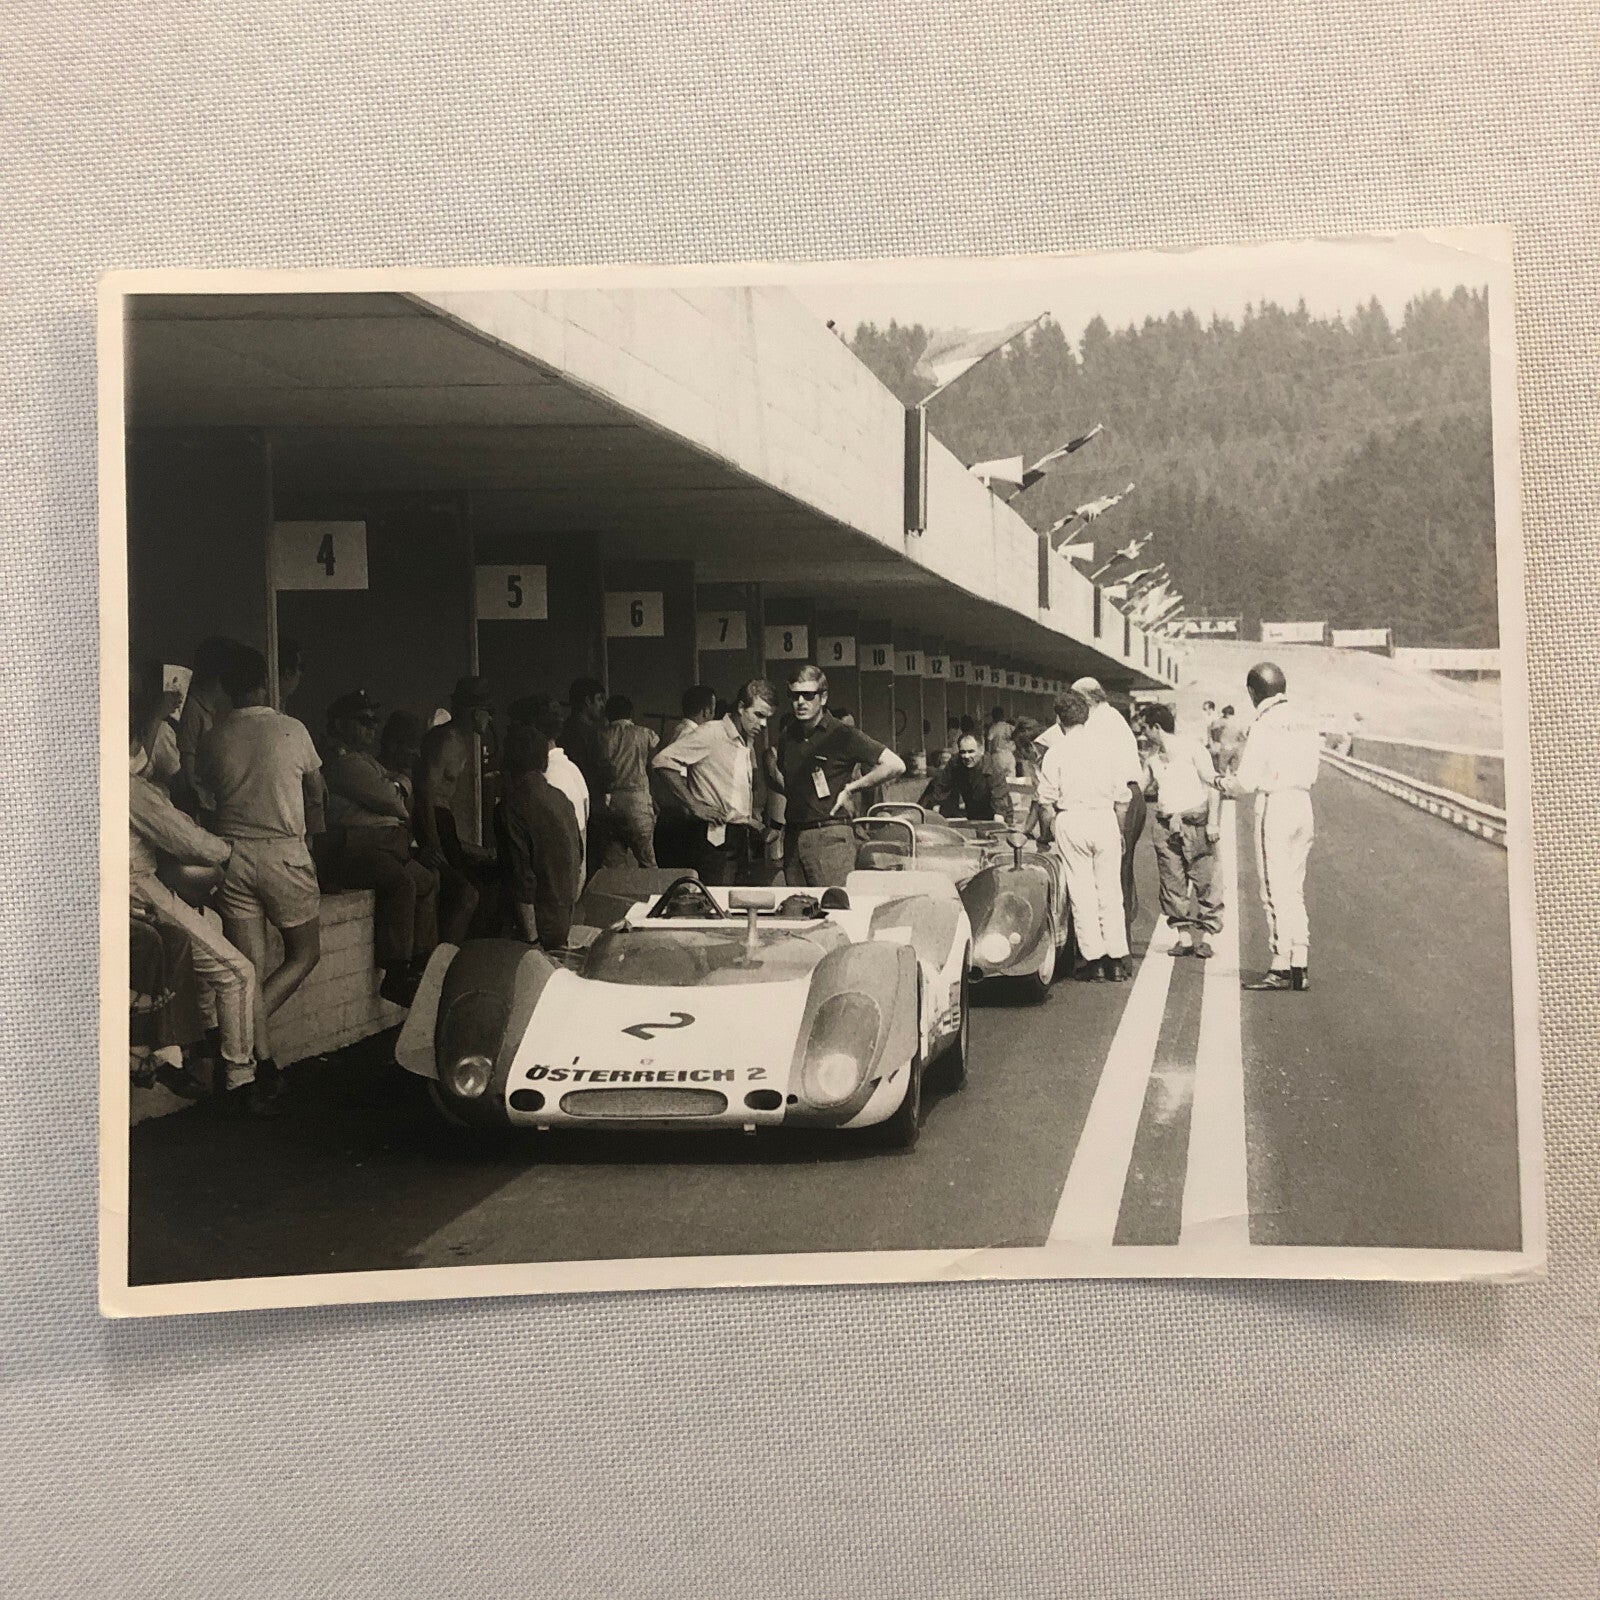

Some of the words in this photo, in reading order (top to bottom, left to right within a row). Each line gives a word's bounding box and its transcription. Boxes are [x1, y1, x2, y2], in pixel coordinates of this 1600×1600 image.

[316, 533, 336, 576] 4
[507, 575, 523, 609] 5
[630, 600, 644, 628] 6
[718, 617, 729, 642] 7
[783, 631, 793, 653] 8
[833, 642, 843, 661] 9
[873, 649, 885, 666] 10
[906, 654, 915, 671] 11
[932, 659, 942, 674] 12
[621, 1012, 696, 1040] 2
[525, 1064, 735, 1082] ÖSTERREICH
[747, 1067, 768, 1080] 2
